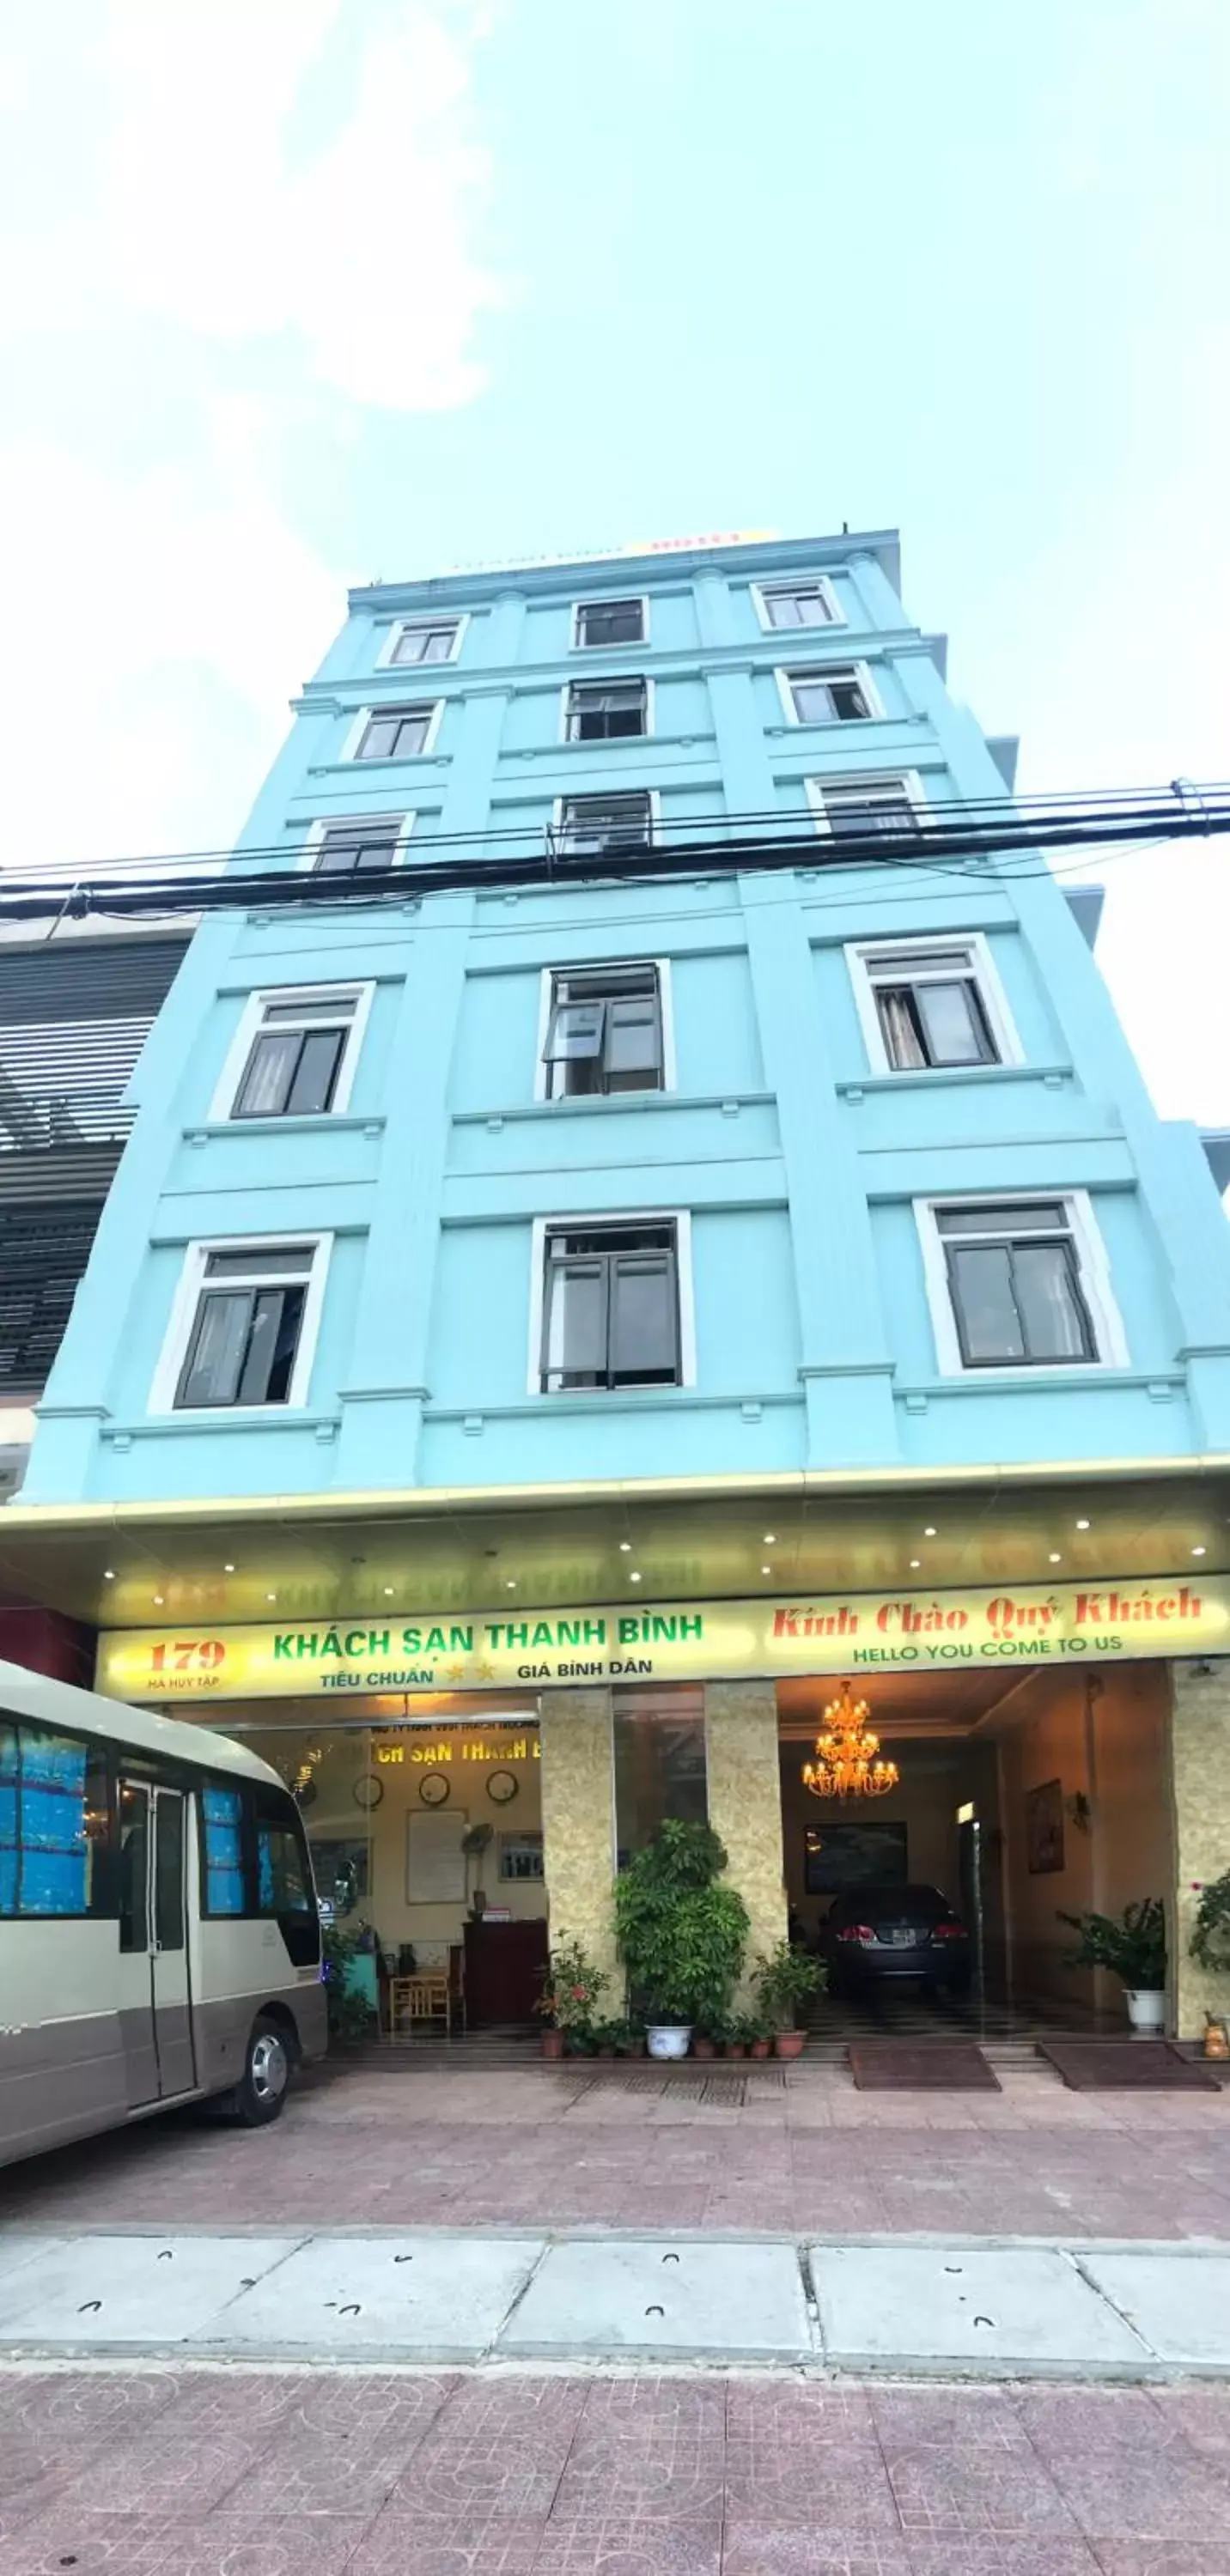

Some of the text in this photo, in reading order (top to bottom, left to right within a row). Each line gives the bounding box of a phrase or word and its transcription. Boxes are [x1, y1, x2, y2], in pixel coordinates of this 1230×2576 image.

[877, 1601, 969, 1633] Chào
[1074, 1587, 1203, 1624] Khách
[274, 1609, 703, 1663] KHÁCH SẠN THANH BÌNH
[853, 1636, 1123, 1663] HELLO YOU COME TO US
[149, 1640, 225, 1672] 179
[320, 1670, 360, 1688] TIÊU
[517, 1662, 551, 1679] GIÁ
[609, 1656, 653, 1674] DÂN
[169, 1675, 193, 1688] HUY
[411, 1741, 453, 1766] SẠN
